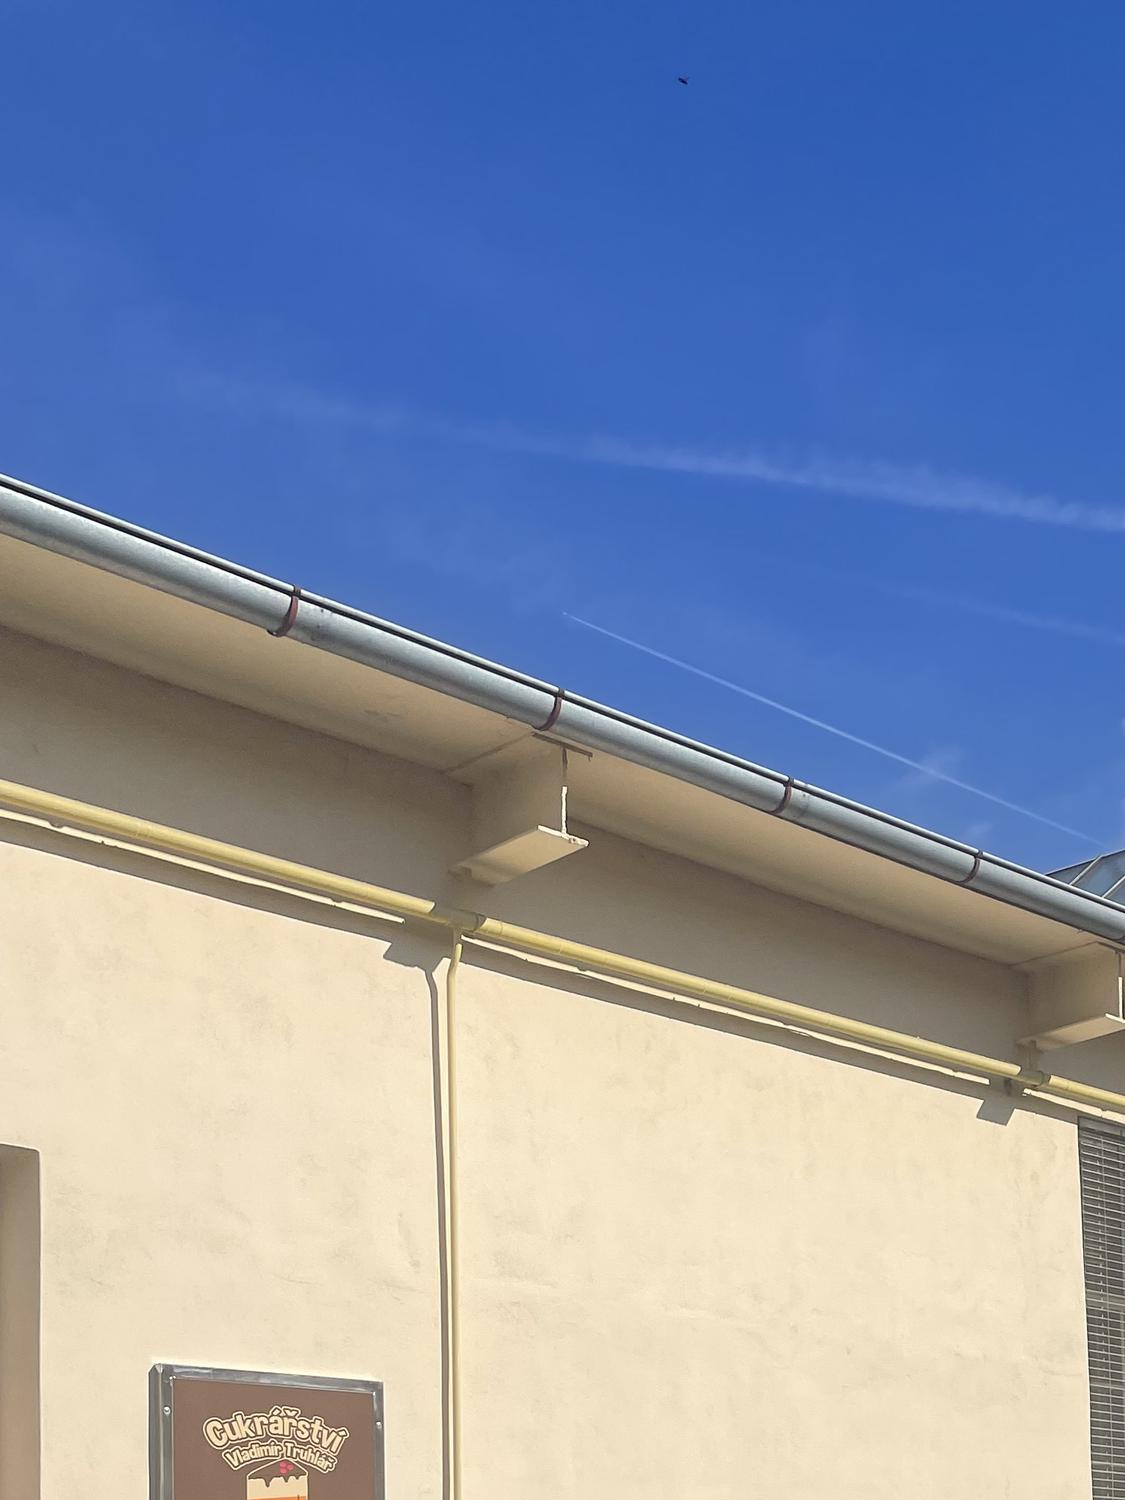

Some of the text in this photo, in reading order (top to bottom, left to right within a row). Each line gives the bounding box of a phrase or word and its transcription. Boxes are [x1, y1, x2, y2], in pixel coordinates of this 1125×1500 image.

[205, 1407, 348, 1453] Cukrářství
[224, 1441, 335, 1471] Vladimír Truhlář
